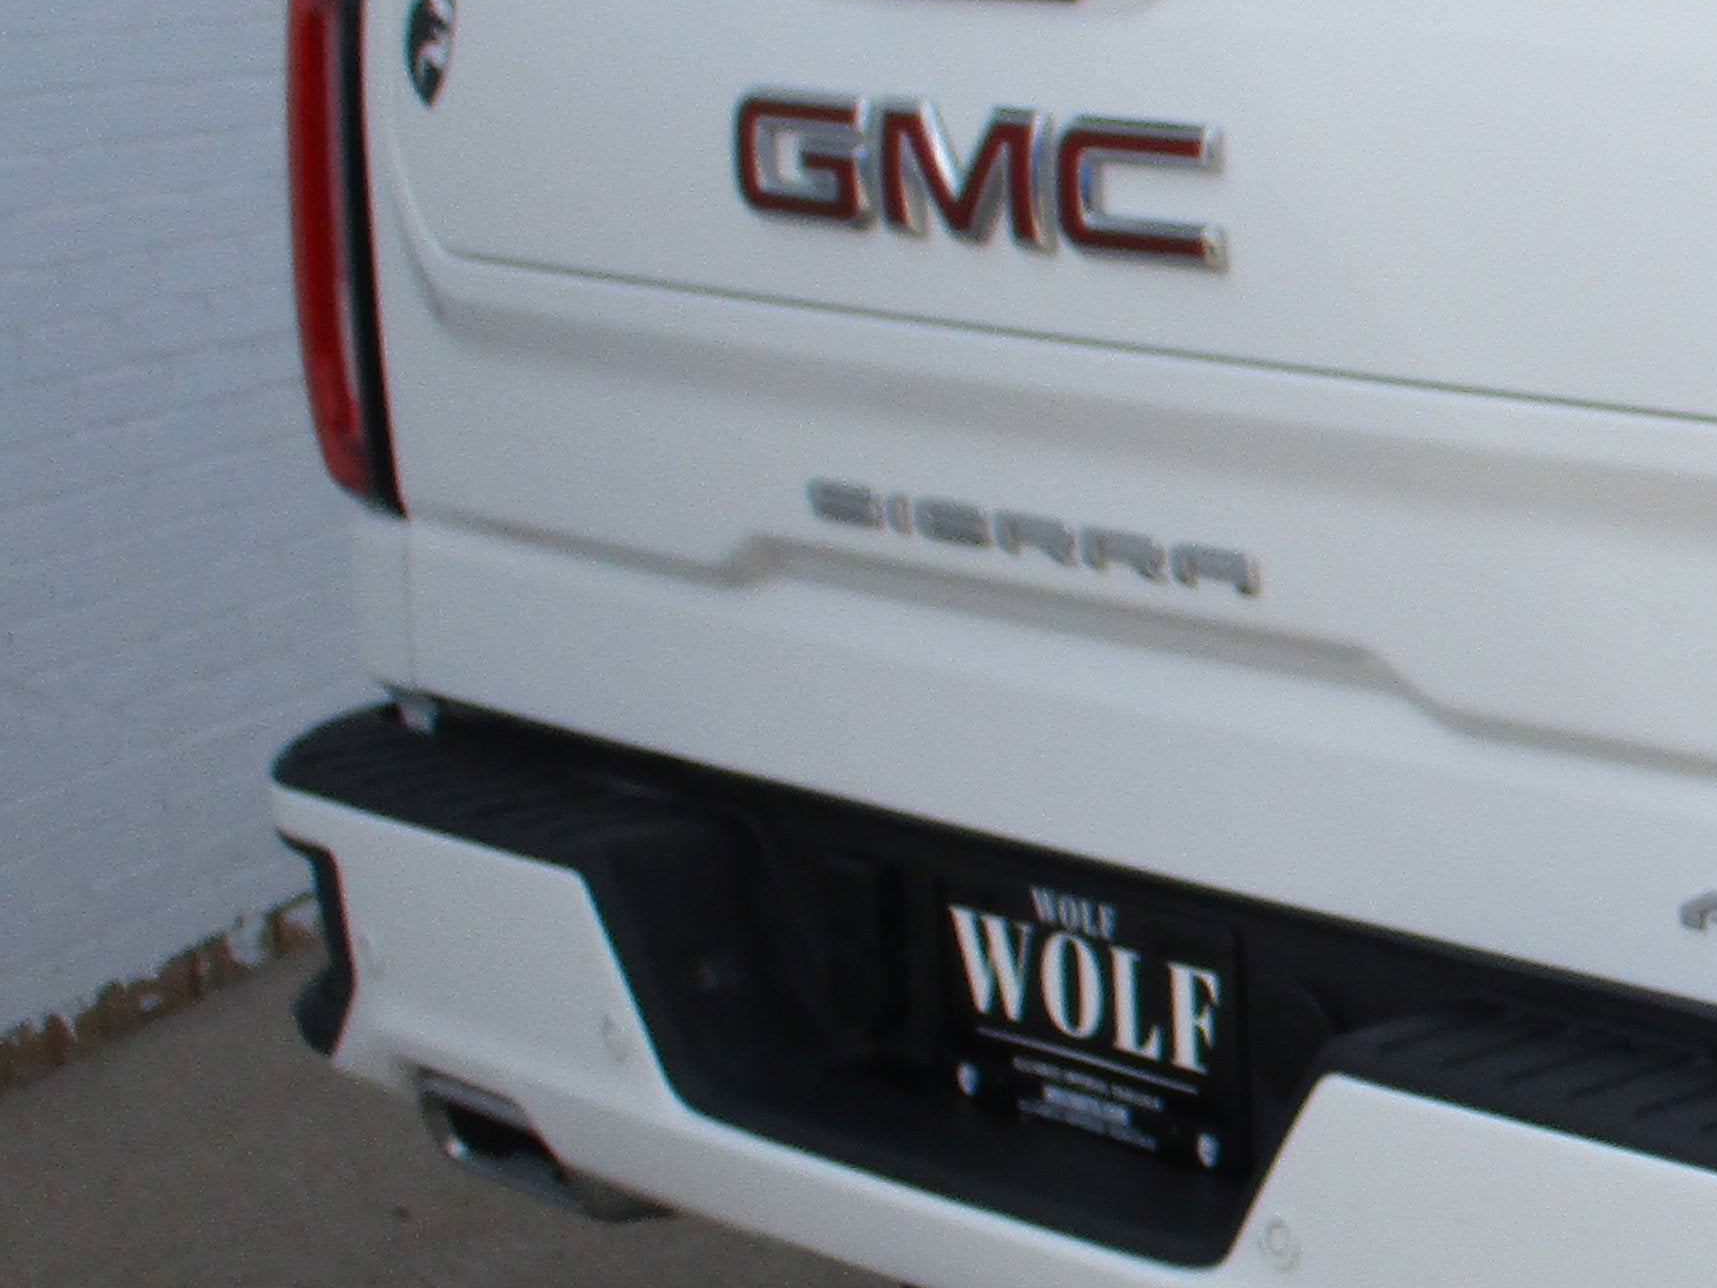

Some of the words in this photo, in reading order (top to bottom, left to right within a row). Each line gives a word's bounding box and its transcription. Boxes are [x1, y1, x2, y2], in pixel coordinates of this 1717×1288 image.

[736, 87, 1229, 274] GMC
[808, 478, 1260, 597] SIERRA
[949, 903, 1222, 1075] WOLF
